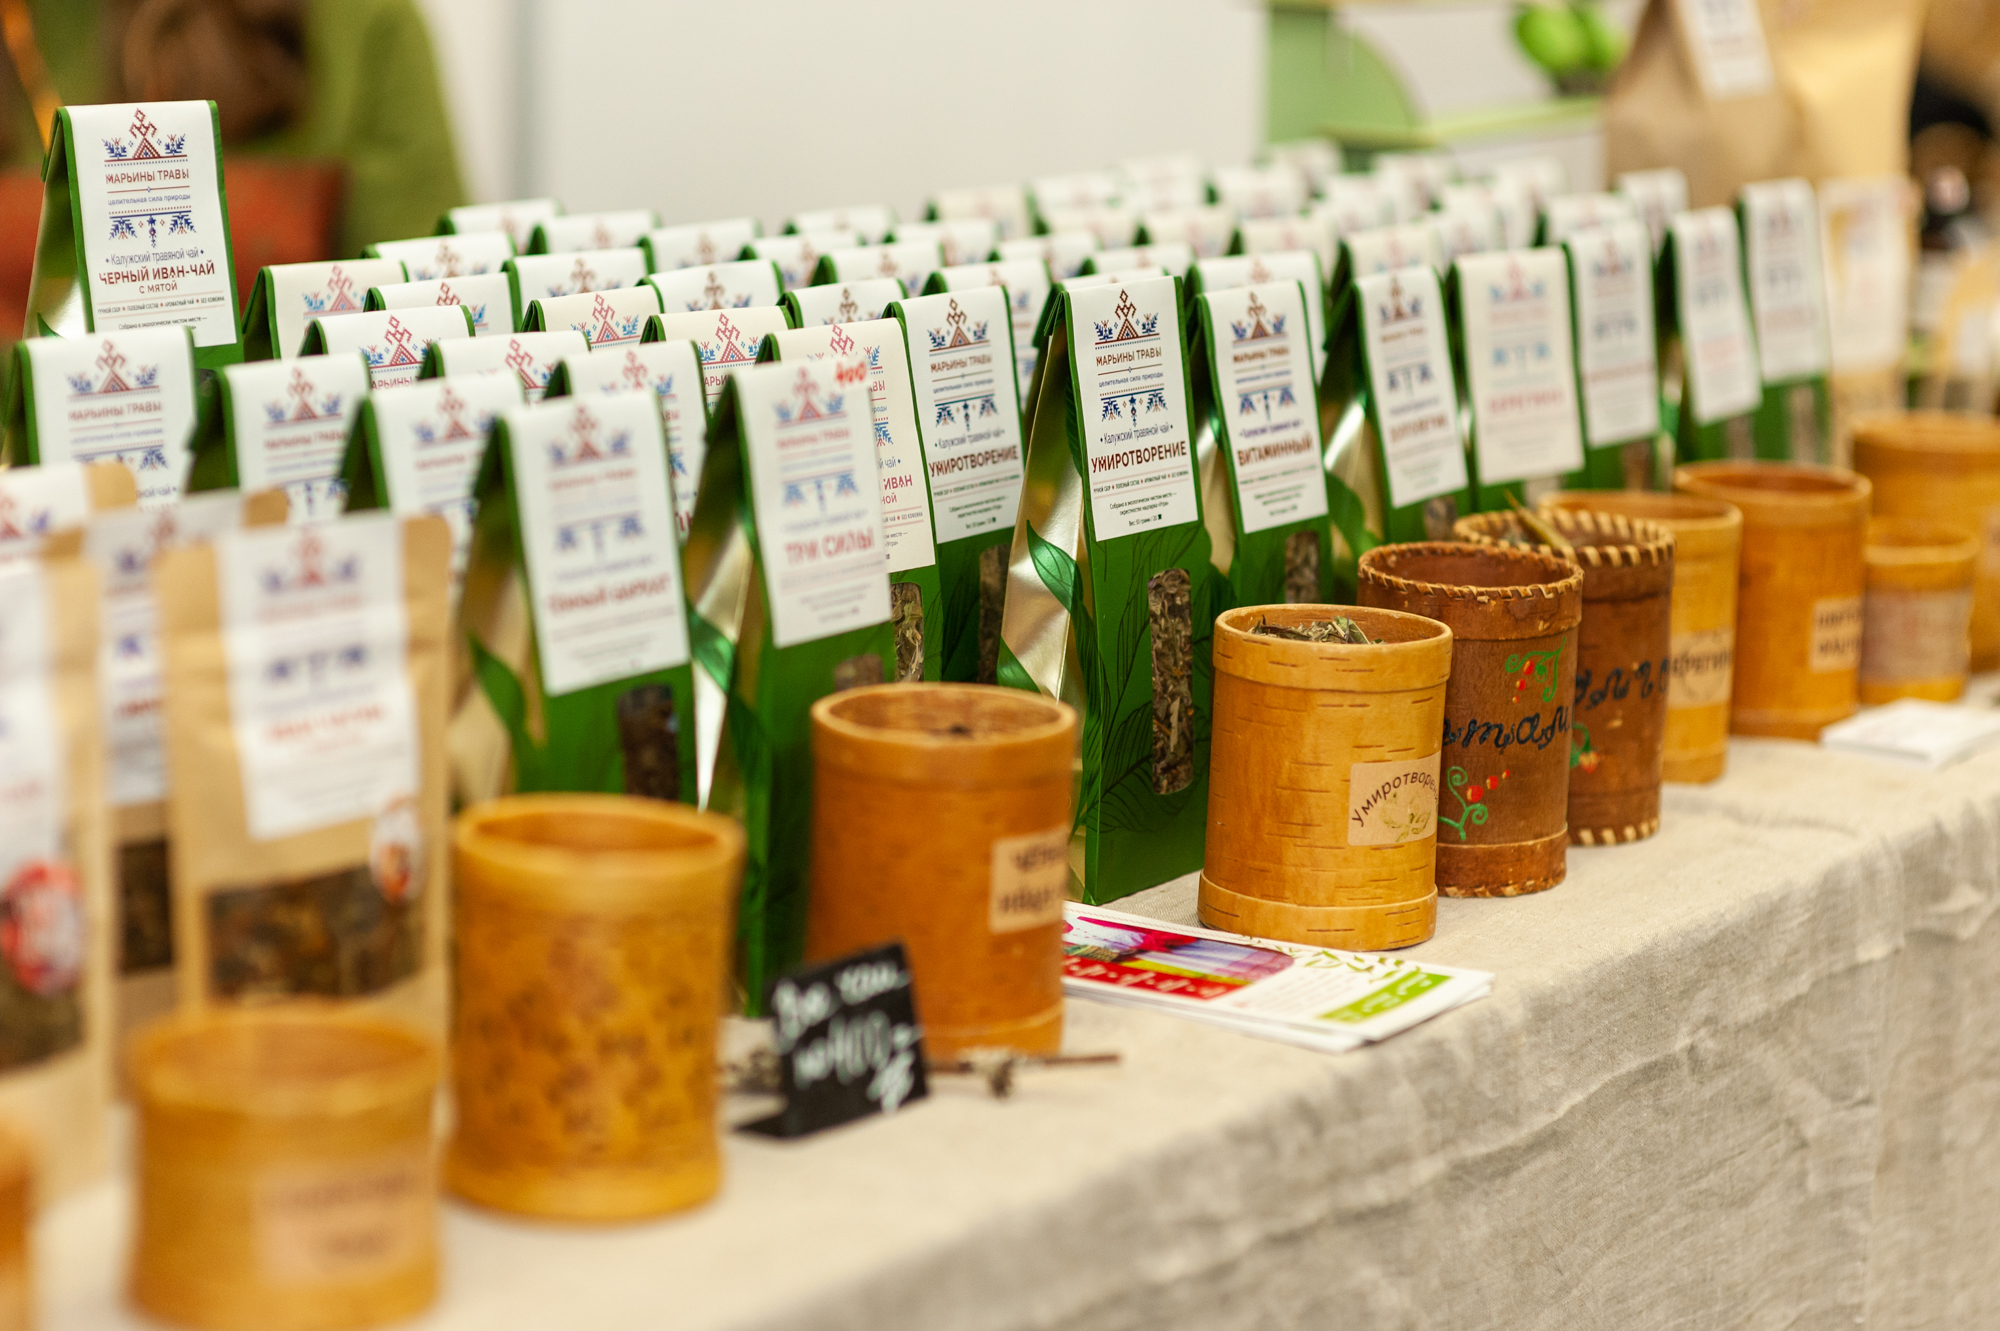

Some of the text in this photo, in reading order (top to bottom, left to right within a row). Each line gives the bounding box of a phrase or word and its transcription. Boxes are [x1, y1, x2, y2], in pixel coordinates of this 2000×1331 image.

[105, 168, 190, 184] МАРЬИНЫ ТРАВЫ
[108, 196, 147, 206] целительная
[164, 193, 191, 202] природы
[111, 247, 199, 267] Калужский травяной чай
[99, 260, 215, 285] ЧЕРНЫЙ ИВАН-ЧАЙ
[147, 280, 178, 293] МЯТОЙ
[1096, 347, 1162, 367] МАРЬИНЫ ТРАВЫ
[371, 376, 414, 390] АРЬИНЫ
[704, 374, 728, 387] АРЬИ
[1099, 377, 1129, 388] целительная
[1142, 372, 1164, 381] природы
[1103, 422, 1169, 446] Калужский травяной чай
[1091, 441, 1187, 473] УМИРОТВОРЕНИЕ
[1237, 431, 1312, 467] ВИТАМИННЫЙ
[885, 456, 896, 469] чай
[929, 445, 1018, 478] УМИРОТВОРЕНИЕ
[784, 526, 875, 567] ТРИ СИЛЫ
